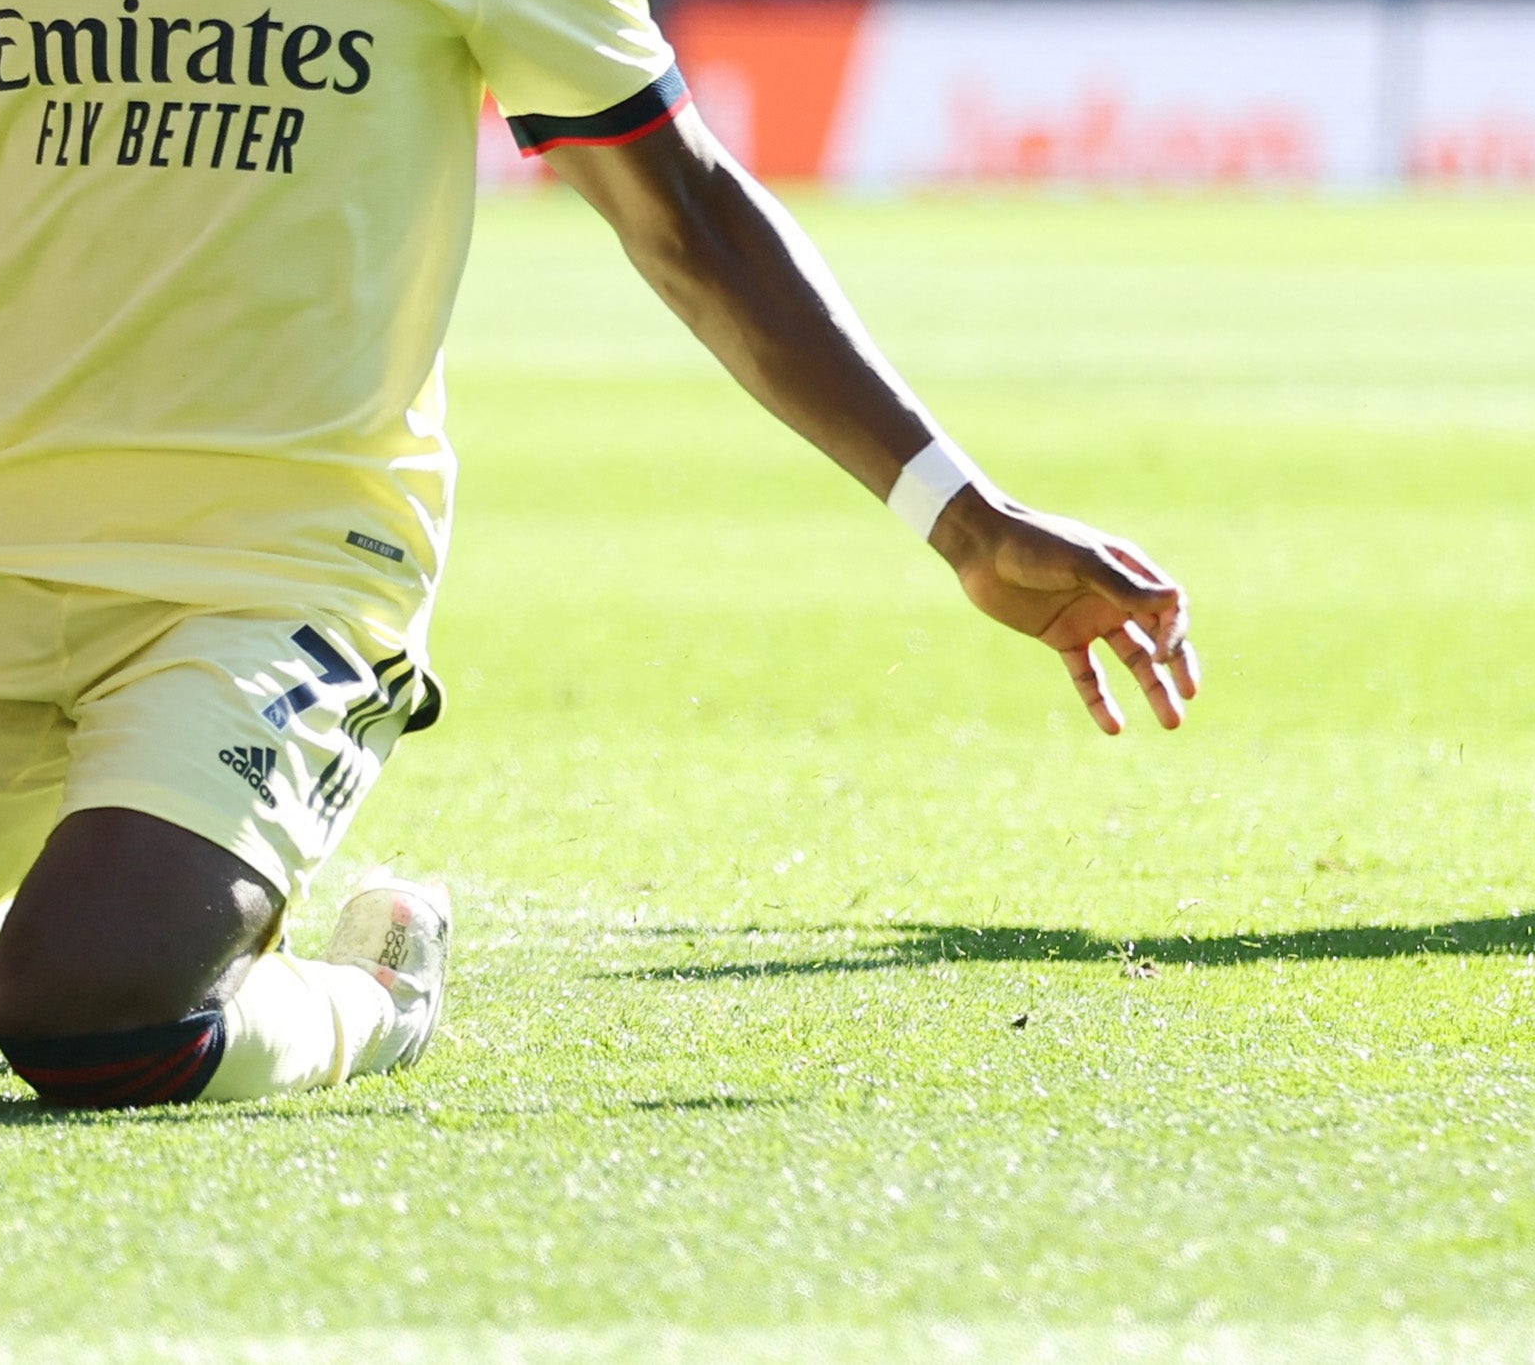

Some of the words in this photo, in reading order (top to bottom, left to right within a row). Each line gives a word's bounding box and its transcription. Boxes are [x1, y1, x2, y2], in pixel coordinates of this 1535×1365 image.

[36, 100, 104, 166] FLY
[116, 100, 305, 175] BETTER
[261, 623, 363, 733] 7
[218, 747, 279, 810] adidas
